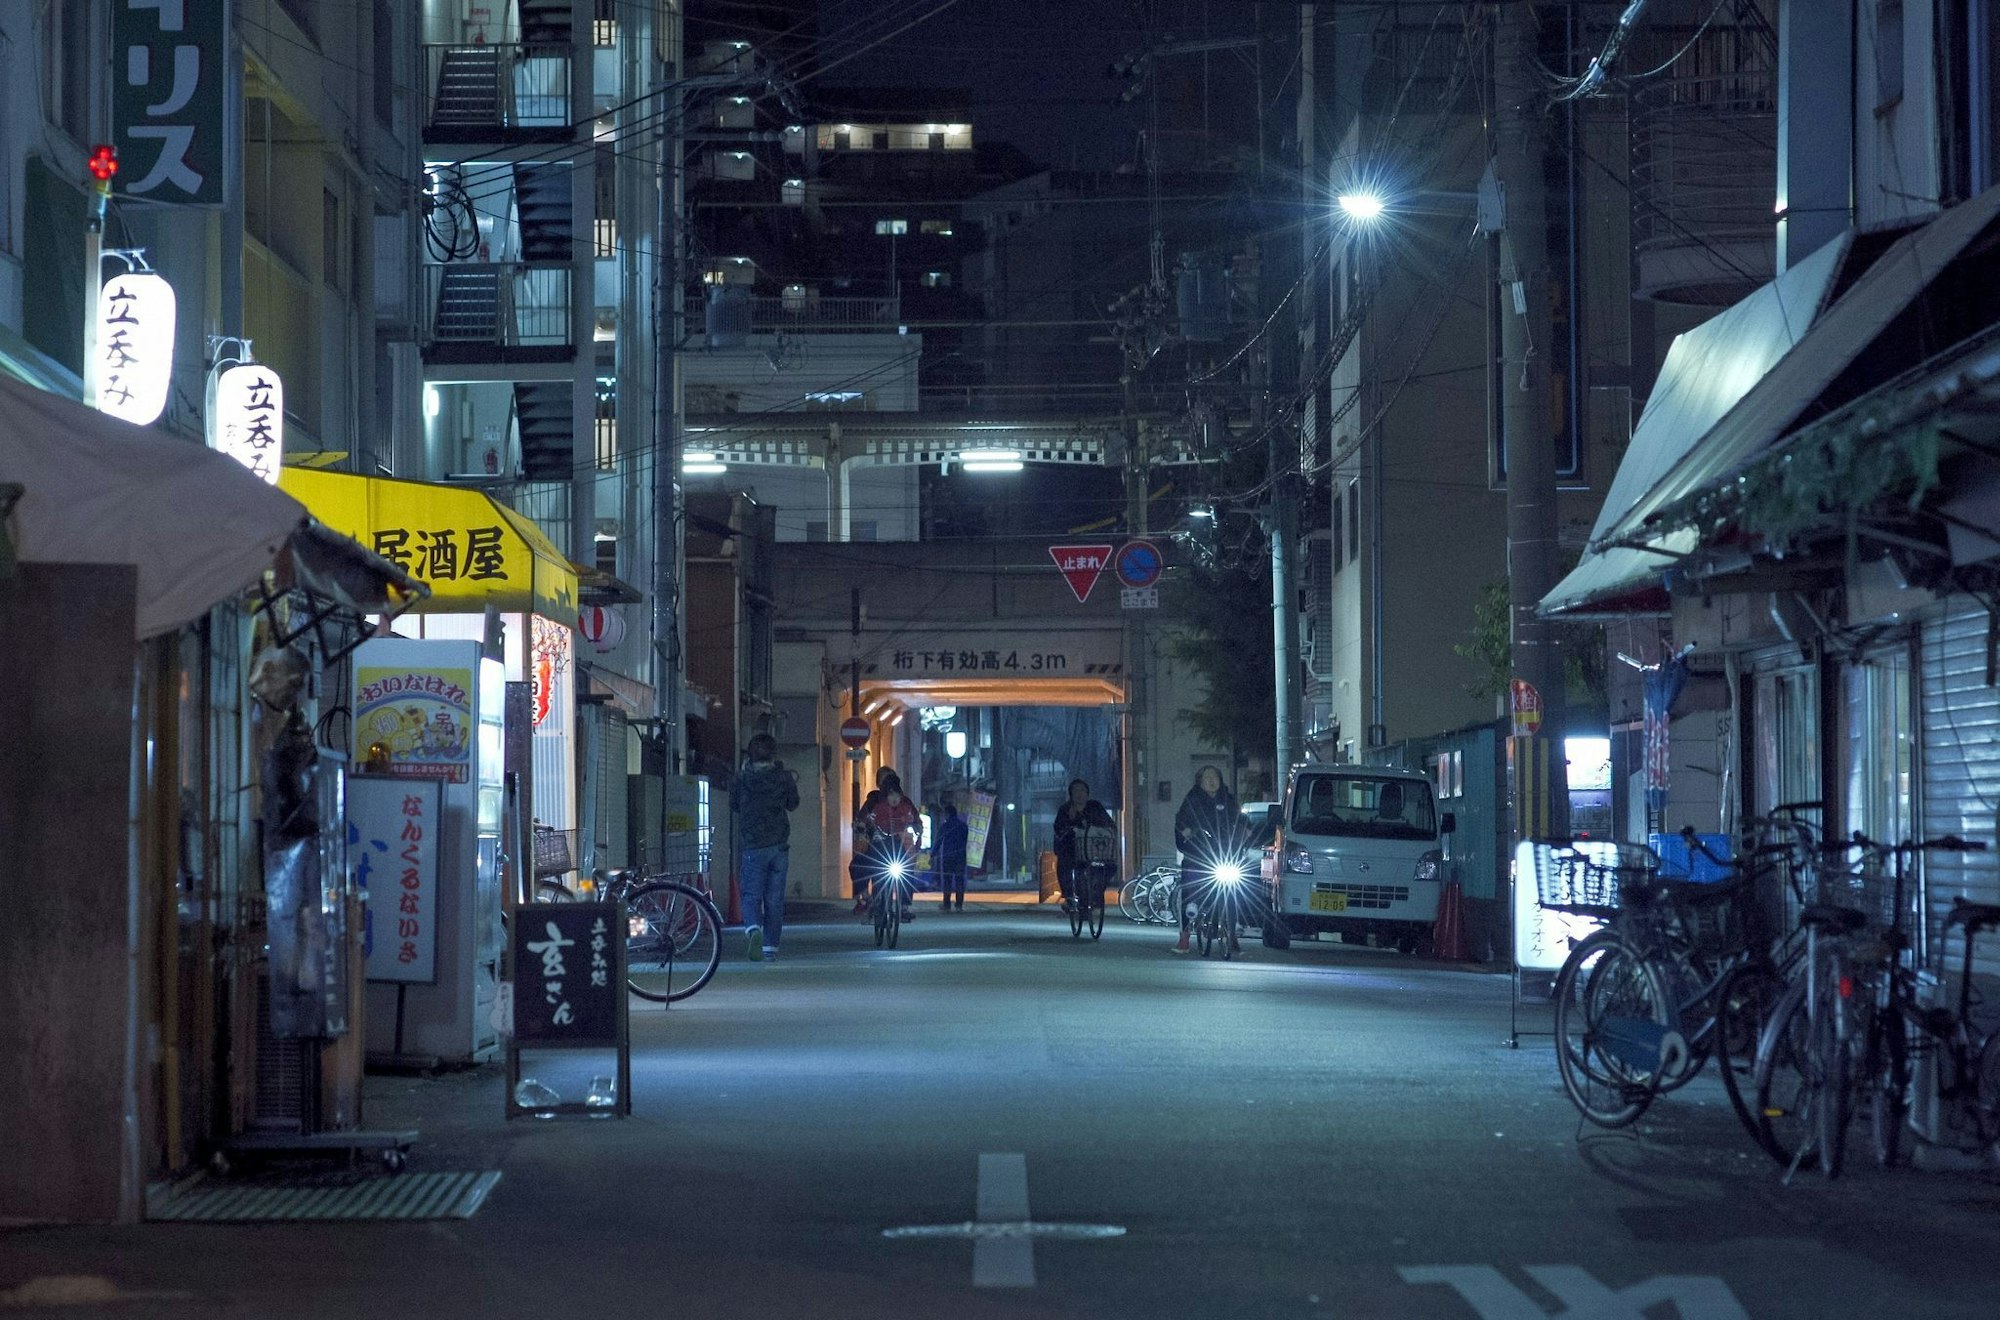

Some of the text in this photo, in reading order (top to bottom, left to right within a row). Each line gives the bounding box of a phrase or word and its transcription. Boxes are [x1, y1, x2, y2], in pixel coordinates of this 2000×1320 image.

[104, 286, 140, 406] 立呑み
[243, 377, 275, 480] 立呑み
[371, 525, 509, 581] 居酒屋
[1063, 556, 1100, 570] 止まれ
[363, 673, 466, 704] おいなはれ
[892, 650, 1066, 671] 桁下有効高4.3m
[399, 795, 423, 964] なんくるないさ
[527, 921, 575, 1025] 玄さん
